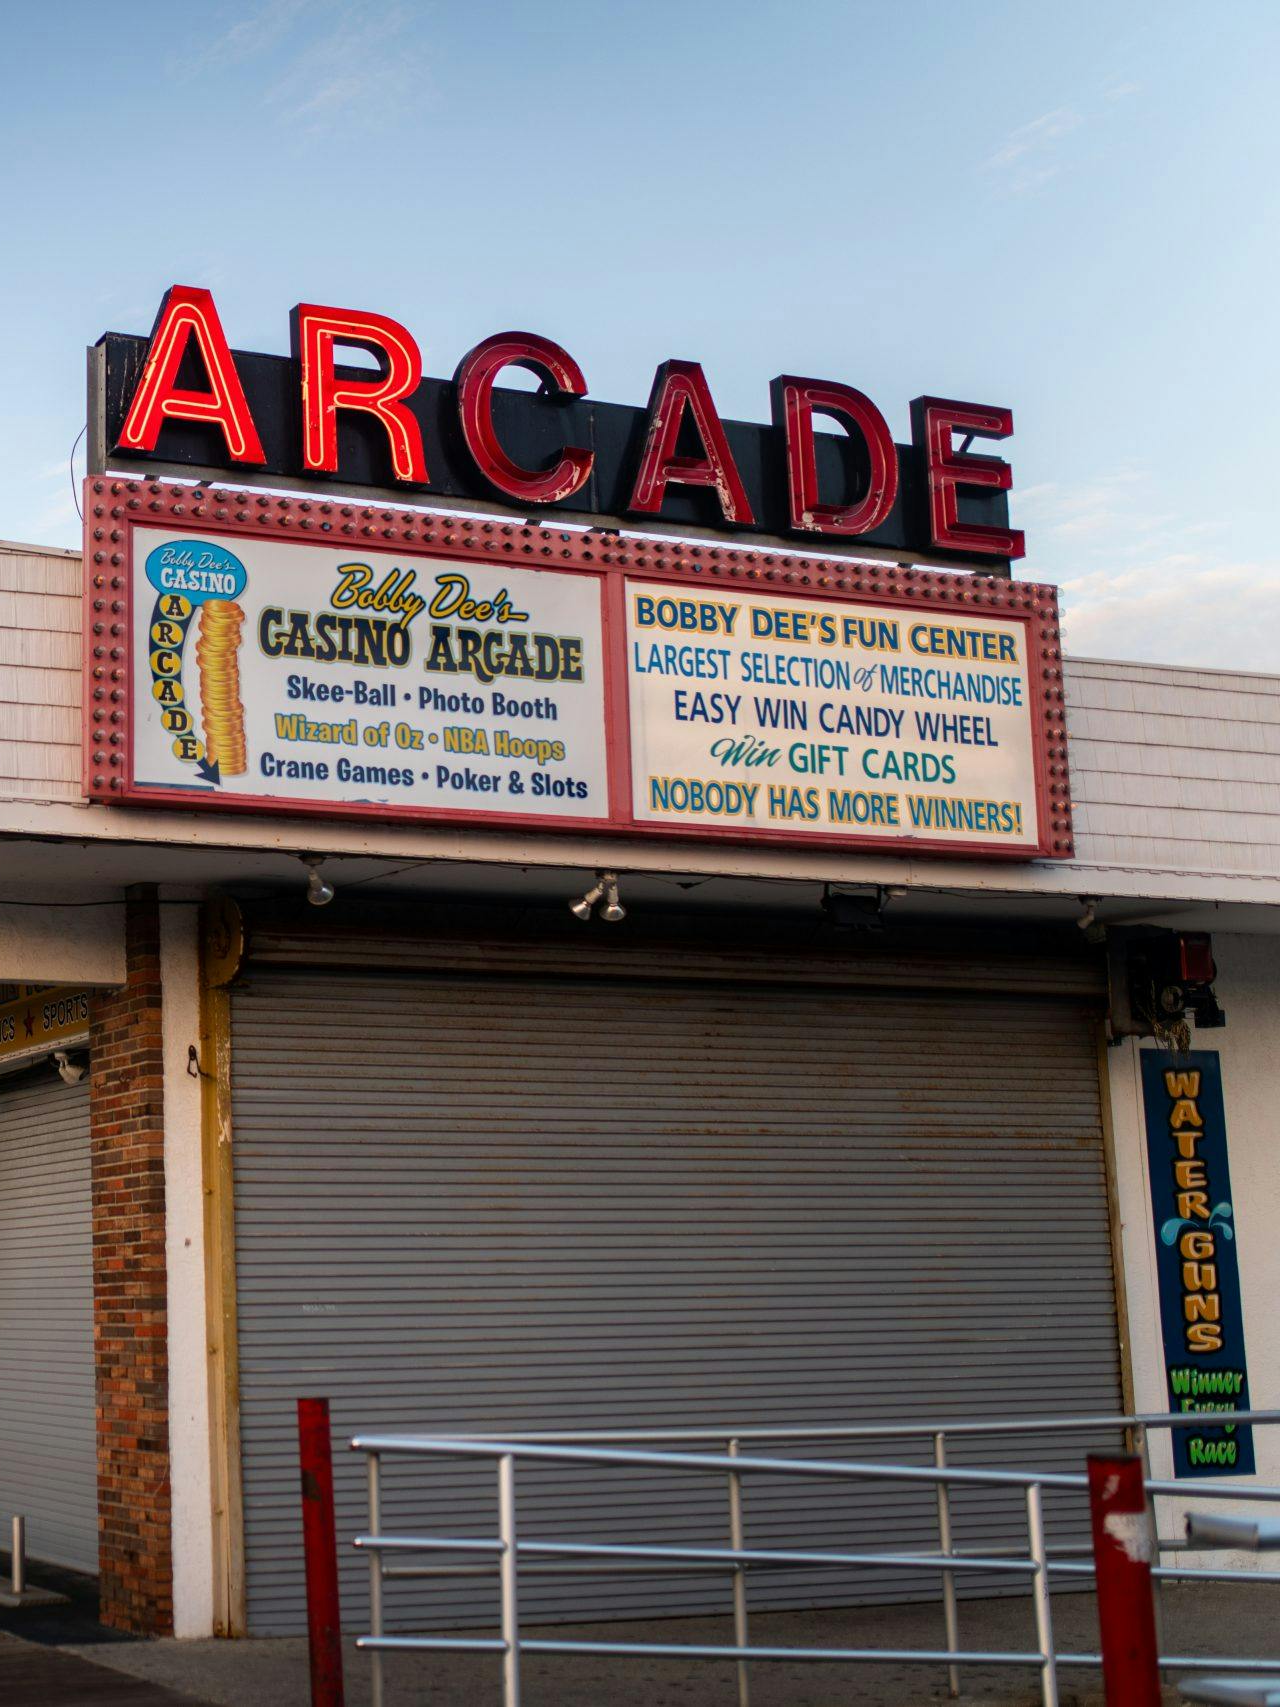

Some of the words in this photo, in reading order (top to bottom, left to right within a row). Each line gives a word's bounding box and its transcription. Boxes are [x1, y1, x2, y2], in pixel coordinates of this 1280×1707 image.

[120, 285, 1026, 559] ARCADE
[160, 548, 197, 571] Bobby
[196, 553, 236, 572] Dee's
[160, 565, 236, 596] CASINO
[331, 563, 424, 628] Bobby
[430, 573, 528, 623] Dee's
[259, 605, 411, 668] CASINO
[424, 624, 585, 685] ARCADE
[634, 593, 740, 636] BOBBY
[750, 606, 838, 646] DEE'S
[842, 615, 901, 653] FUN
[908, 623, 1020, 664] CENTER
[157, 595, 198, 761] ARCADE
[286, 675, 397, 707] Skee-Ball
[418, 687, 485, 716] Photo
[492, 692, 559, 722] Booth
[634, 642, 731, 679] LARGEST
[741, 651, 851, 691] SELECTION
[853, 663, 879, 692] of
[880, 664, 1023, 707] MERCHANDISE
[274, 713, 358, 746] Wizard
[362, 721, 391, 747] of
[394, 723, 424, 751] Oz
[444, 727, 489, 756] NBA
[494, 732, 565, 765] Hoops
[674, 689, 742, 725] EASY
[755, 697, 808, 731] WIN
[819, 703, 905, 740] CANDY
[915, 711, 999, 748] WHEEL
[260, 751, 330, 781] Crane
[336, 756, 415, 787] Games
[436, 765, 501, 795] Poker
[508, 769, 525, 795] &
[531, 771, 589, 799] Slots
[709, 733, 783, 769] Win
[788, 742, 850, 776] GIFT
[861, 748, 957, 786] CARDS
[647, 776, 761, 818] NOBODY
[767, 784, 821, 822] HAS
[827, 790, 901, 827] MORE
[906, 795, 1025, 836] WINNERS!
[41, 991, 89, 1033] SPORTS
[1164, 1070, 1211, 1220] WATER
[1182, 1231, 1224, 1353] GUNS
[1171, 1369, 1243, 1396] Winner
[1190, 1438, 1236, 1465] Race
